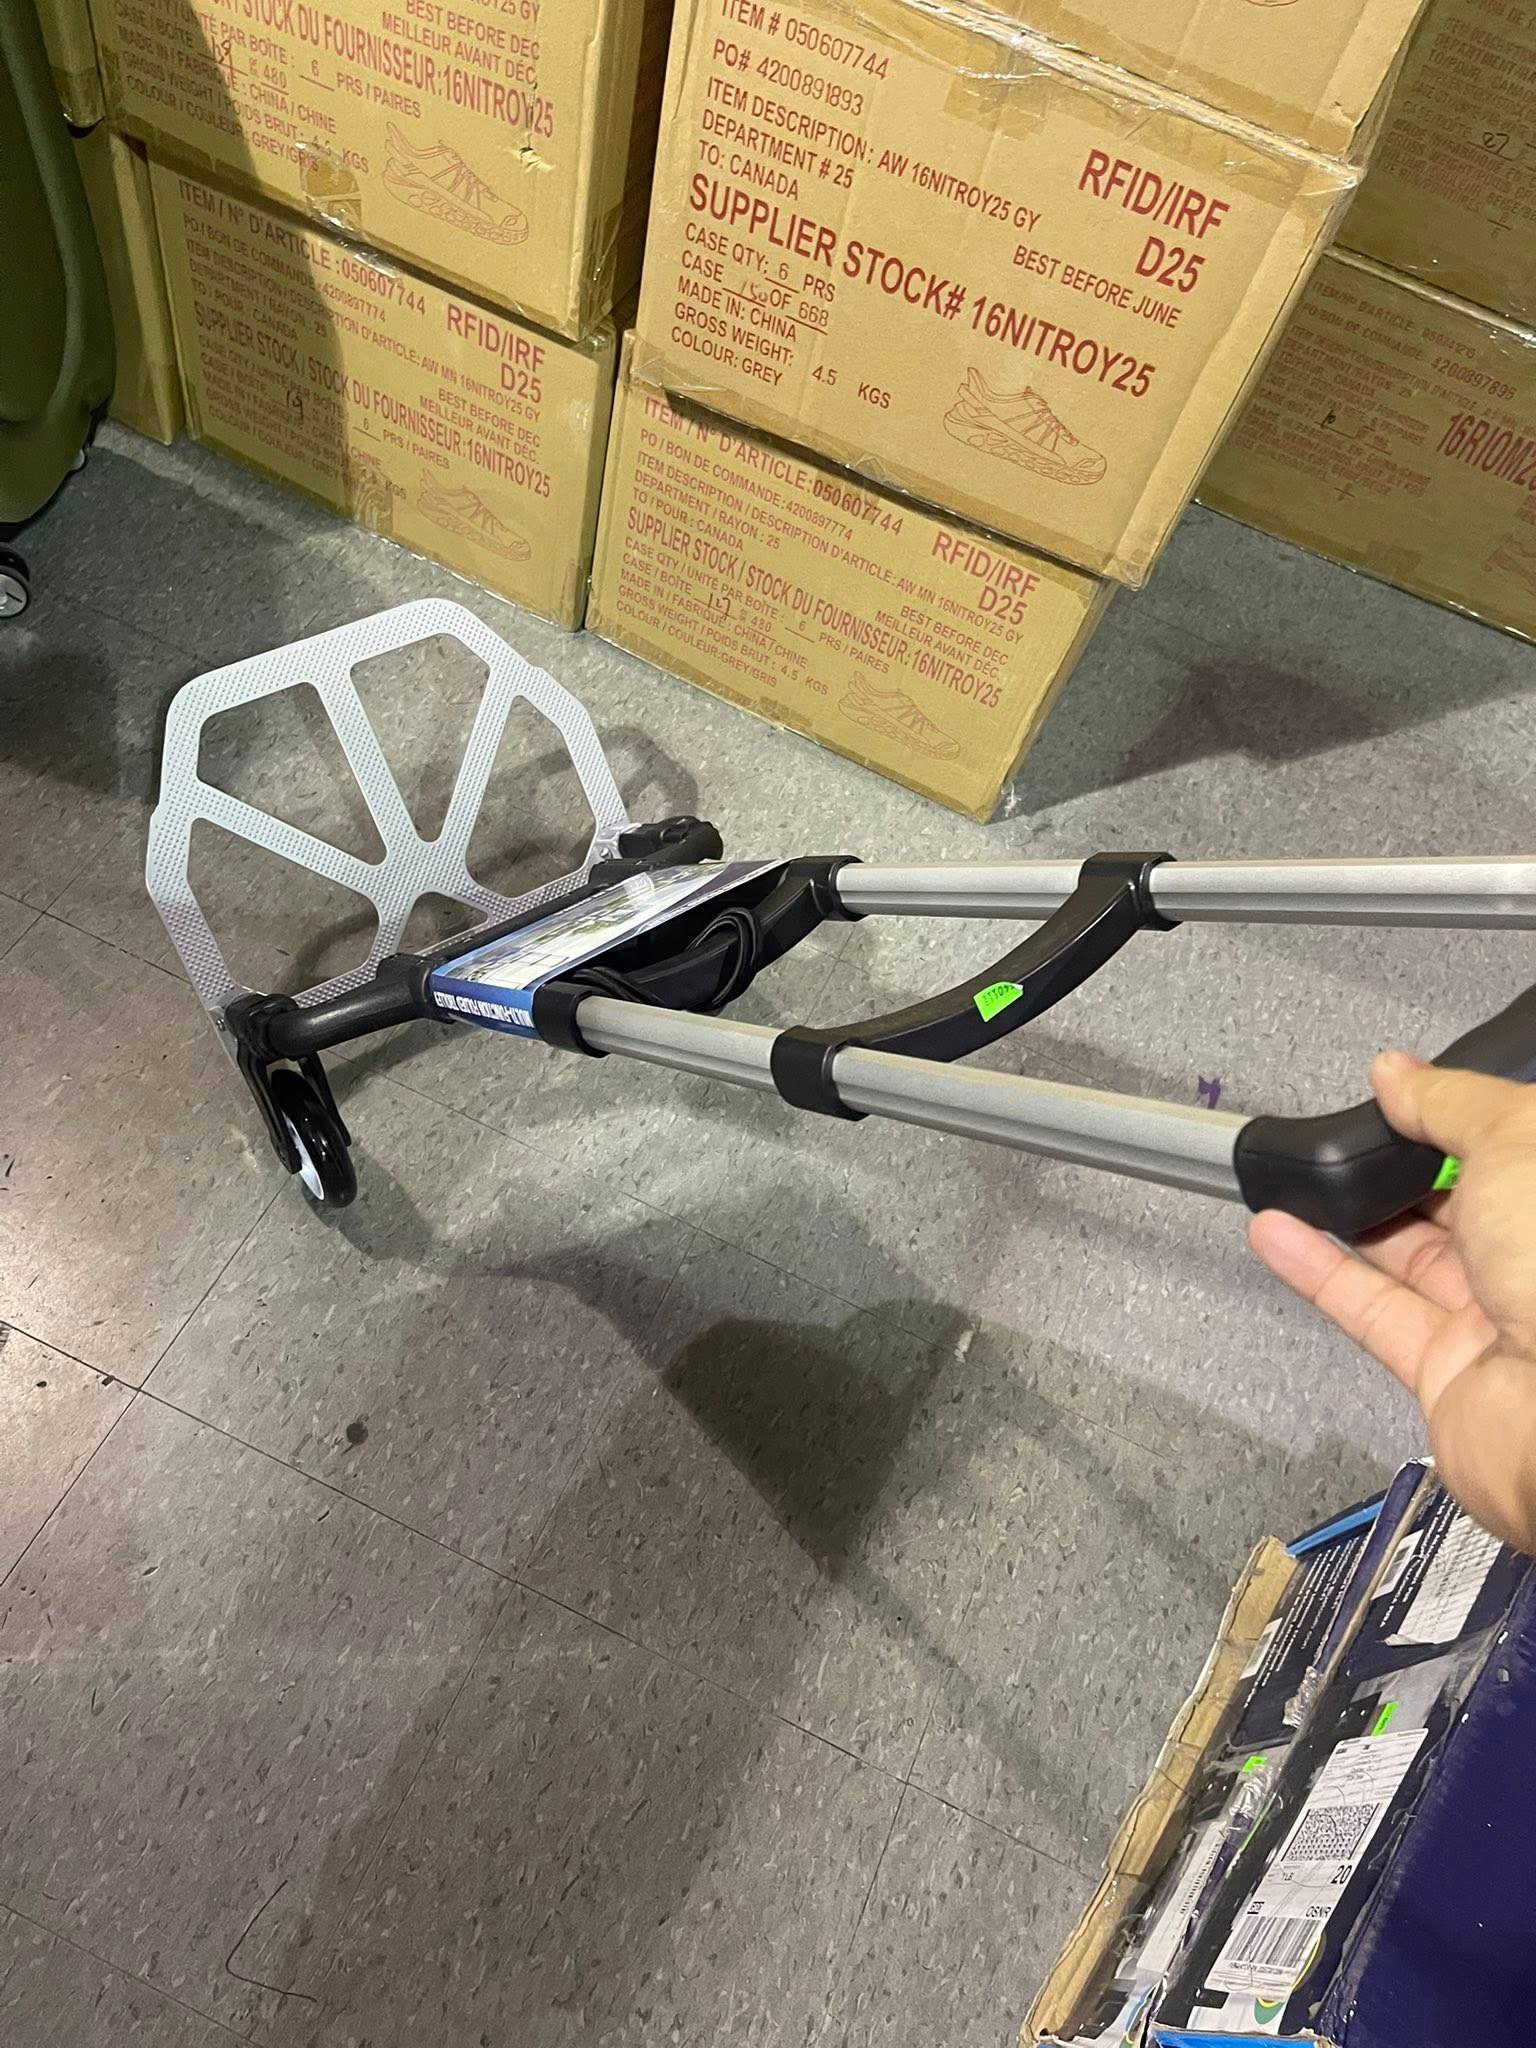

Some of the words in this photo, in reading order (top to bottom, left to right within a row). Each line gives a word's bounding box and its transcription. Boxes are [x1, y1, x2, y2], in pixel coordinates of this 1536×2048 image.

[298, 4, 319, 46] DU
[382, 11, 450, 55] MEILLEUR
[454, 41, 502, 76] AVANT
[406, 0, 443, 25] BEST
[447, 11, 506, 49] BEFORE
[509, 34, 540, 60] DEC
[721, 0, 765, 31] ITEM
[785, 18, 889, 80] 050607744
[311, 59, 320, 77] 6
[336, 72, 362, 97] PRS
[373, 86, 422, 119] PAIRES
[713, 38, 751, 72] PO#
[756, 57, 864, 116] 4200891893
[265, 116, 298, 139] BRUT
[342, 148, 369, 173] KGS
[297, 104, 336, 134] CHINE
[702, 109, 817, 173] DEPARTMENT
[833, 164, 854, 188] 25
[698, 139, 725, 169] TO:
[730, 154, 799, 200] CANADA
[707, 76, 748, 112] ITEM
[877, 149, 909, 177] AW
[911, 162, 1011, 221] 16NITROY25
[1013, 207, 1042, 232] GY
[178, 178, 216, 213] ITEM
[249, 212, 331, 271] D'ARTICLE
[1077, 149, 1231, 239] RFID/IRF
[681, 250, 724, 282] CASE
[769, 288, 791, 311] OF
[797, 301, 829, 327] 668
[685, 222, 728, 256] CASE
[732, 243, 769, 275] QTY:
[777, 262, 789, 281] 6
[803, 274, 836, 302] PRS
[690, 173, 836, 267] SUPPLIER
[843, 241, 967, 320] STOCK#
[972, 295, 1156, 398] 16NITROY25
[1013, 244, 1061, 279] BEST
[1060, 264, 1133, 309] BEFORE
[1133, 295, 1182, 328] JUNE
[1135, 236, 1205, 293] D25
[447, 302, 546, 373] RFID/IRF
[677, 275, 722, 309] MADE
[726, 296, 745, 320] IN:
[750, 307, 797, 342] CHINA
[257, 329, 300, 375] STOCK
[307, 356, 350, 399] STOCK
[352, 378, 370, 410] DU
[500, 361, 542, 404] D25
[671, 326, 739, 367] COLOUR:
[741, 358, 783, 386] GREY
[674, 302, 728, 338] GROSS
[732, 325, 794, 367] WEIGHT:
[811, 365, 838, 386] 4.5
[858, 382, 891, 409] KGS
[419, 395, 474, 430] MEILLEUR
[475, 424, 511, 448] AVANT
[438, 387, 468, 411] BEST
[470, 404, 515, 434] BEFORE
[517, 428, 541, 448] DEC
[525, 406, 541, 423] GY
[643, 397, 684, 434] ITEM
[412, 444, 450, 470] PAIRES
[640, 428, 658, 448] PO
[665, 441, 693, 465] BON
[694, 455, 711, 473] DE
[632, 487, 650, 505] TO
[656, 499, 688, 525] POUR
[696, 519, 744, 551] CANADA
[634, 469, 716, 515] DEPARTMENT
[719, 510, 760, 540] RAYON
[766, 533, 781, 550] 25
[623, 553, 652, 576] CASE
[627, 506, 691, 558] SUPPLIER
[692, 538, 741, 580] STOCK
[746, 564, 793, 608] STOCK
[792, 587, 813, 616] DU
[637, 451, 664, 474] ITEM
[666, 464, 743, 513] DESCRIPTION
[751, 508, 829, 554] DESCRIPTION
[918, 588, 937, 605] MN
[938, 596, 1005, 637] 16NITROY25
[1005, 627, 1024, 645] GY
[931, 530, 1041, 600] RFID/IRF
[616, 601, 660, 632] COLOUR
[621, 568, 651, 592] MADE
[775, 644, 808, 669] CHINE
[625, 536, 654, 559] CASE
[656, 552, 680, 570] QTY
[686, 567, 719, 592] UNITÉ
[721, 583, 744, 603] PAR
[745, 594, 779, 621] BOÎTE
[798, 620, 806, 633] 6
[818, 632, 842, 651] PRS
[849, 646, 890, 674] PAIRES
[900, 605, 932, 630] BEST
[933, 621, 982, 654] BEFORE
[983, 645, 1009, 667] DEC
[977, 585, 1029, 627] D25
[618, 585, 655, 611] GROSS
[658, 602, 698, 632] WEIGHT
[706, 627, 738, 651] POIDS
[740, 645, 770, 666] BRUT
[781, 665, 798, 681] 4.5
[805, 676, 829, 695] KGS
[874, 610, 933, 648] MEILLEUR
[934, 639, 973, 666] AVANT
[1330, 1865, 1352, 1885] 20
